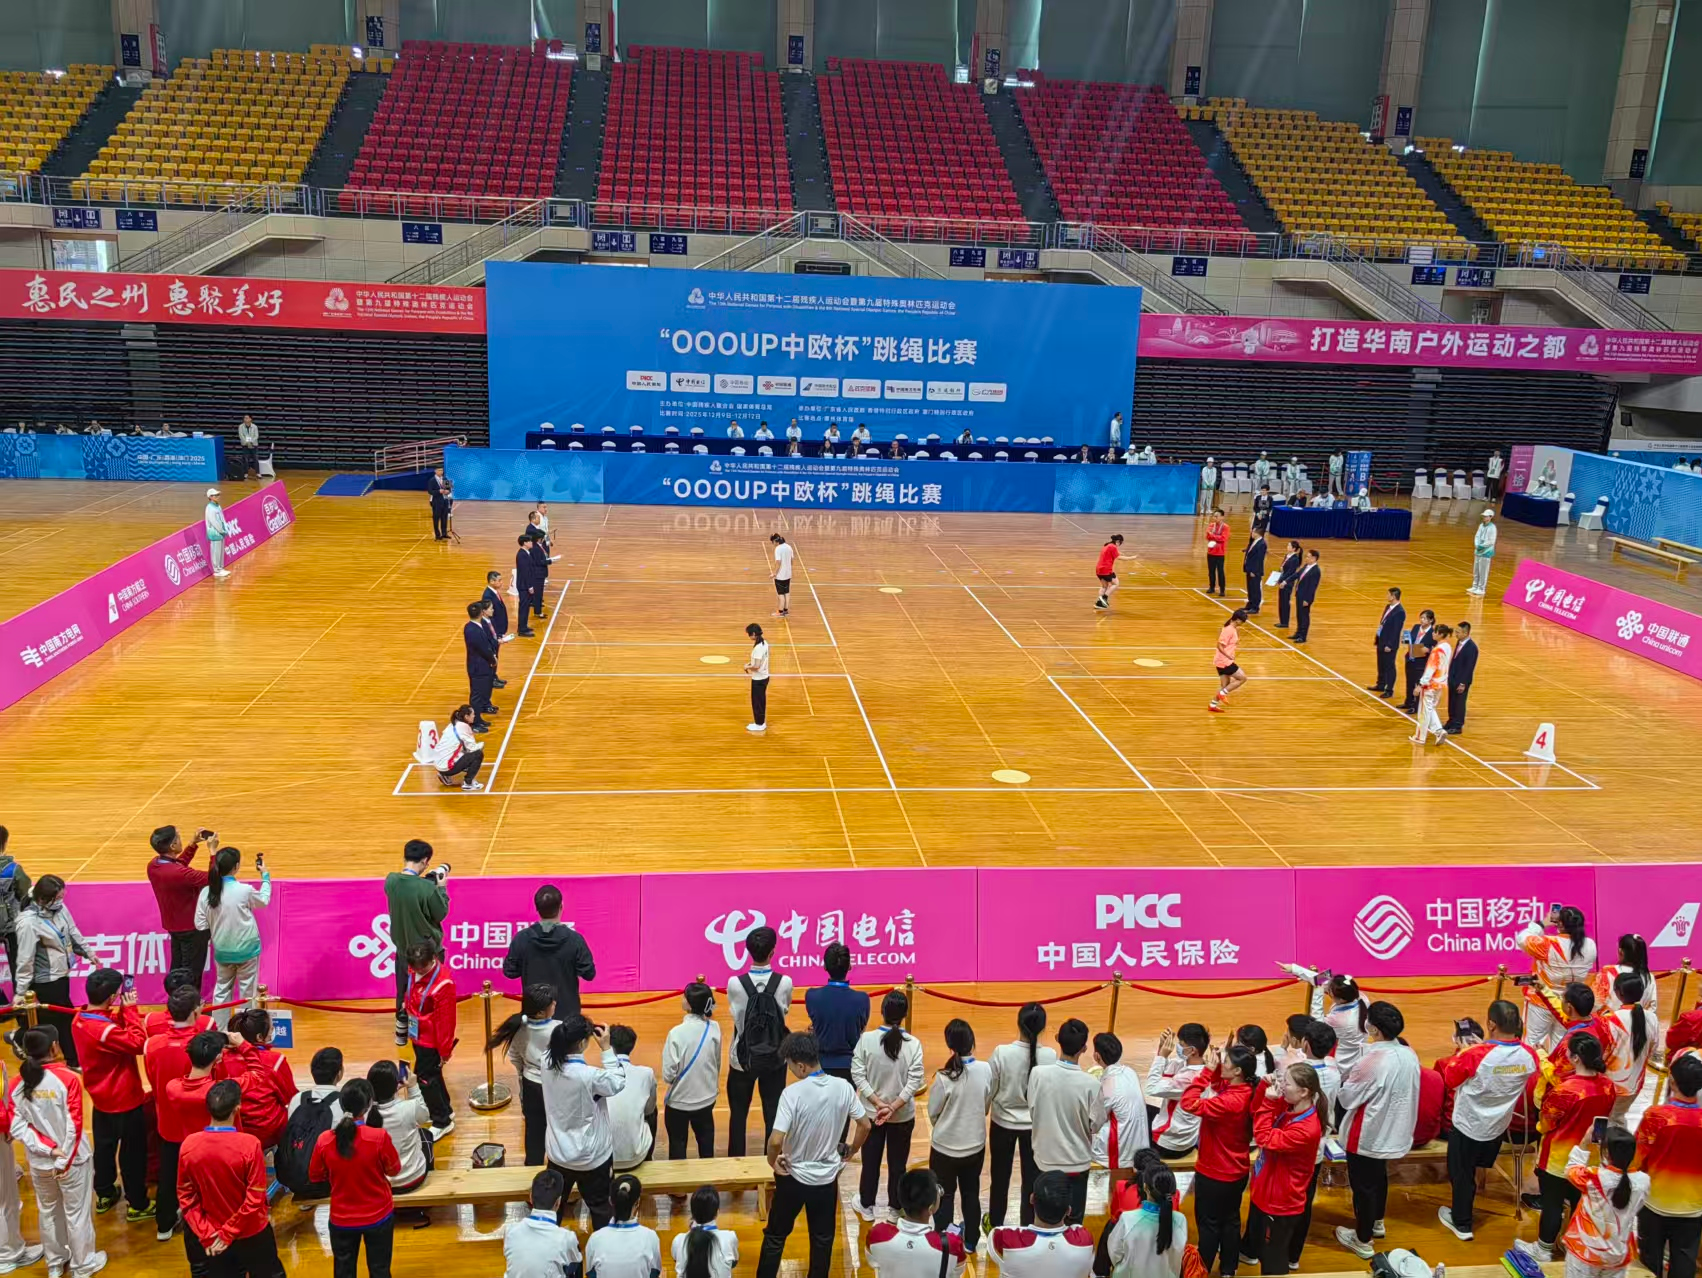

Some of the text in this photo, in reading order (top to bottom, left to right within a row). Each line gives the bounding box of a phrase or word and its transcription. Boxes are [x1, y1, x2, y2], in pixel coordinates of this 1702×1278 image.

[22, 274, 283, 318] 惠民之州 惠聚美好
[708, 292, 957, 310] 中华人民共和国第十二届残疾人运动会暨第九届特殊奥林匹克运动会
[1310, 327, 1567, 359] 打造华南户外运动之都
[1359, 472, 1366, 481] B
[1544, 584, 1585, 613] 中国电信
[39, 623, 81, 656] 中国南方电网
[1642, 636, 1683, 657] China unicom
[1647, 623, 1691, 648] 中国联通
[428, 729, 438, 749] 3
[1536, 731, 1548, 749] 4
[1095, 893, 1182, 930] PICC
[1426, 896, 1545, 929] 中国移动
[778, 908, 916, 955] 中国电信
[1427, 932, 1482, 952] China
[1037, 938, 1240, 971] 中国人民保险
